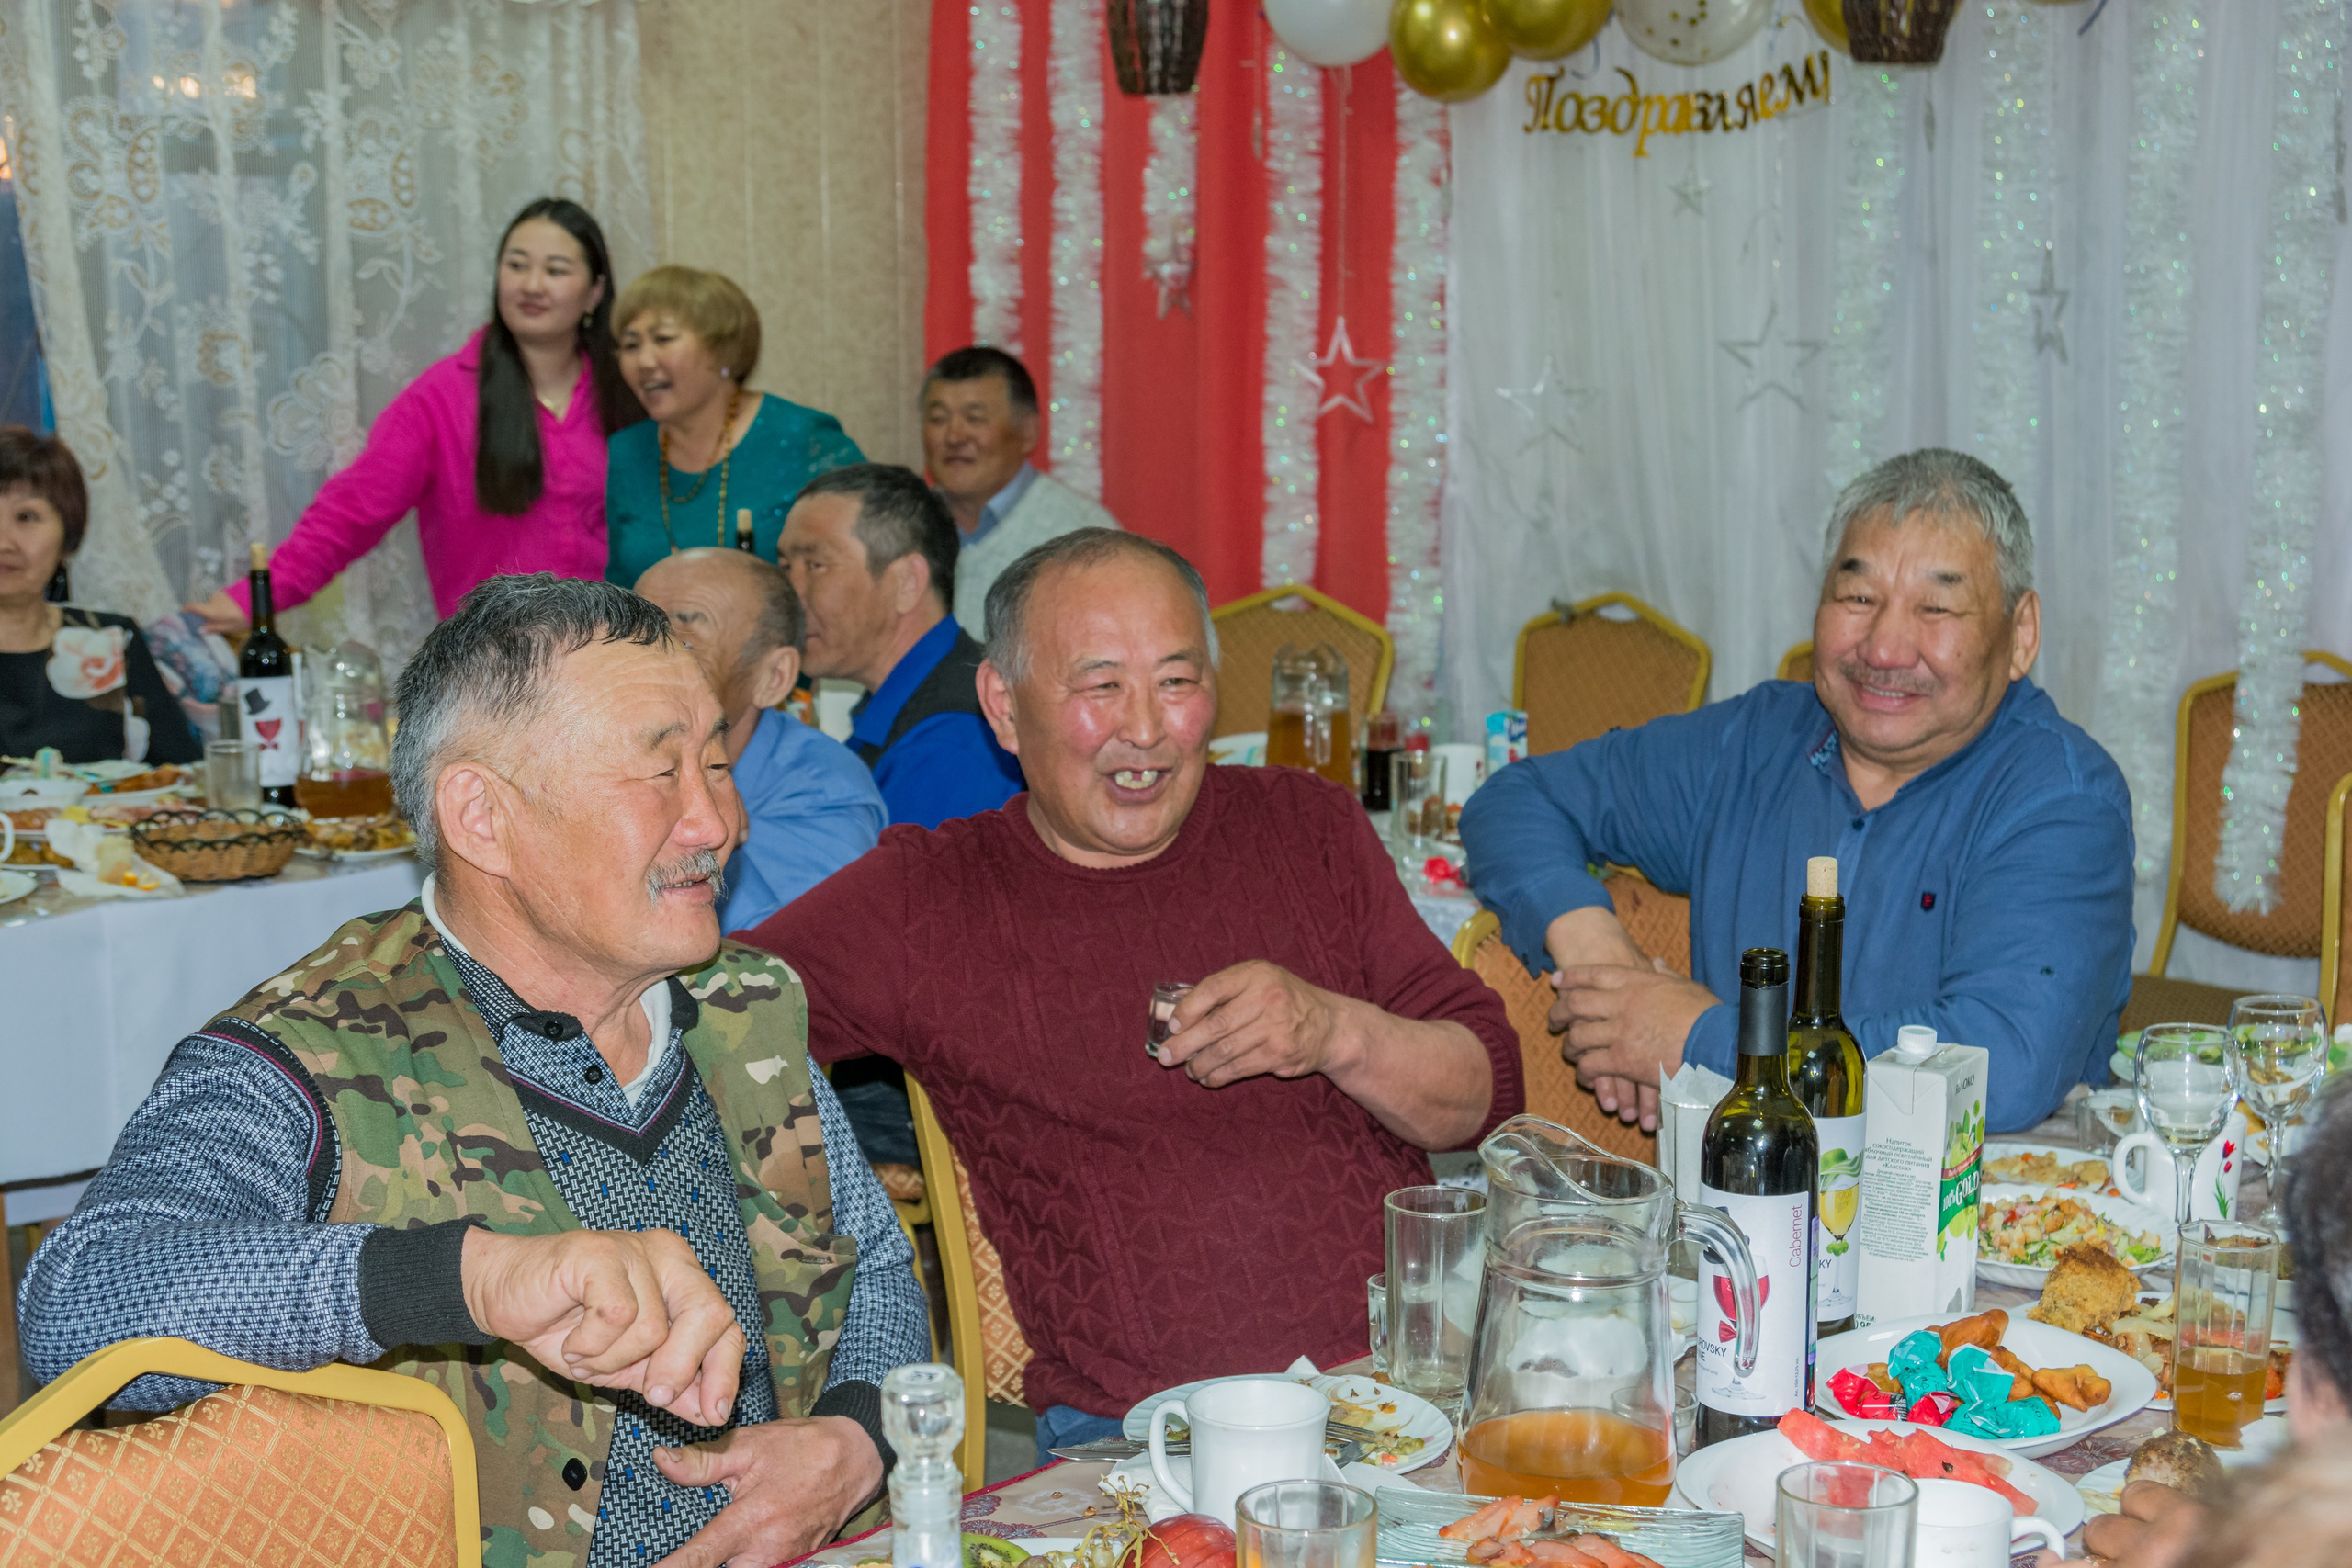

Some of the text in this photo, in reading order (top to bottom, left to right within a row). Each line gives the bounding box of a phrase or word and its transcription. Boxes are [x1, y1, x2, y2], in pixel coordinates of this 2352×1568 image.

[1521, 48, 1832, 159] Поздравляем!
[1885, 1137, 1912, 1147] Напиток
[1877, 1156, 1905, 1165] детского
[1905, 1160, 1930, 1168] питания
[1955, 1170, 1980, 1206] GOLD
[1789, 1203, 1803, 1268] Cabernet
